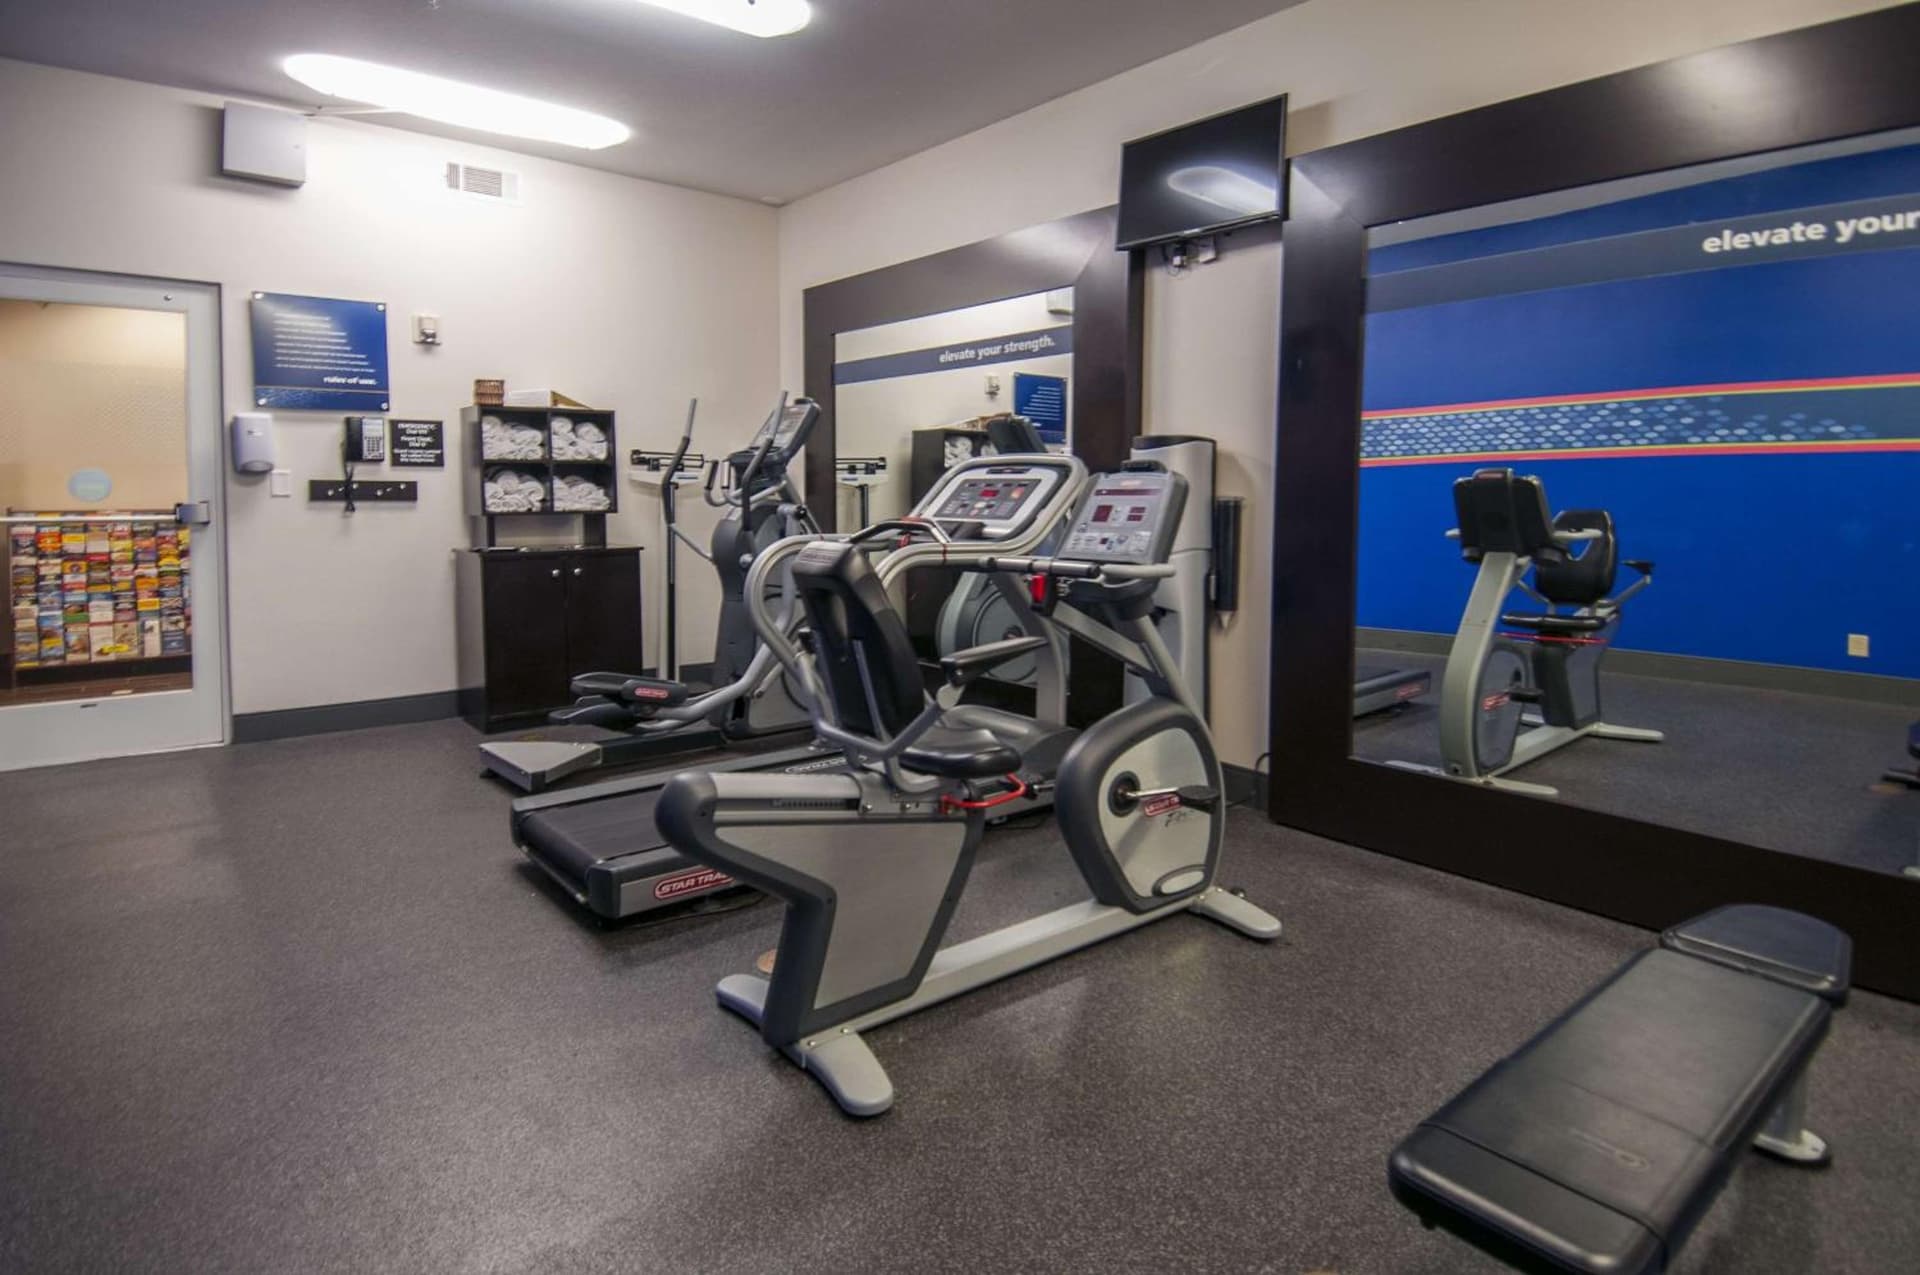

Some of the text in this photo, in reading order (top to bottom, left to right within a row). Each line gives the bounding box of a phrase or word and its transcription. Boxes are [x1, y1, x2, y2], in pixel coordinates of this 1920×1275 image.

[1701, 210, 1920, 253] elevate your
[938, 334, 1056, 363] elevate your strength.
